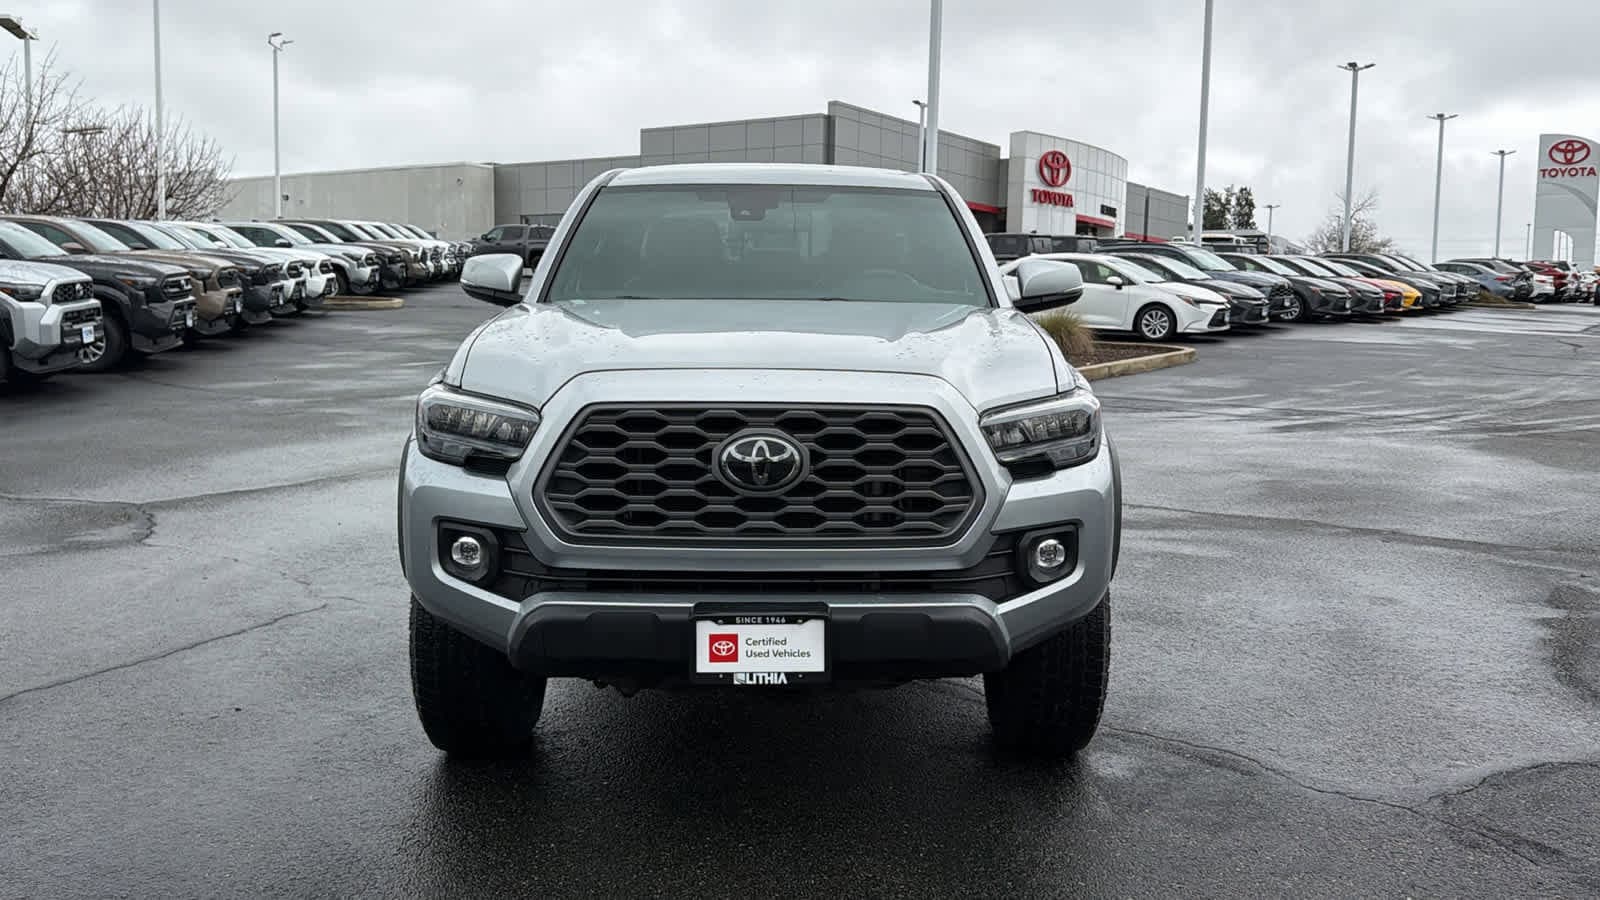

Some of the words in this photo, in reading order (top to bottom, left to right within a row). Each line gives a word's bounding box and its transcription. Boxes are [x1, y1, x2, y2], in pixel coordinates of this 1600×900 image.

[1540, 167, 1597, 178] TOYOTA
[1031, 189, 1073, 207] TOYOTA
[745, 637, 787, 646] Certified
[745, 649, 770, 658] Used
[772, 648, 811, 658] Vehicles
[745, 673, 788, 684] LITHIA
